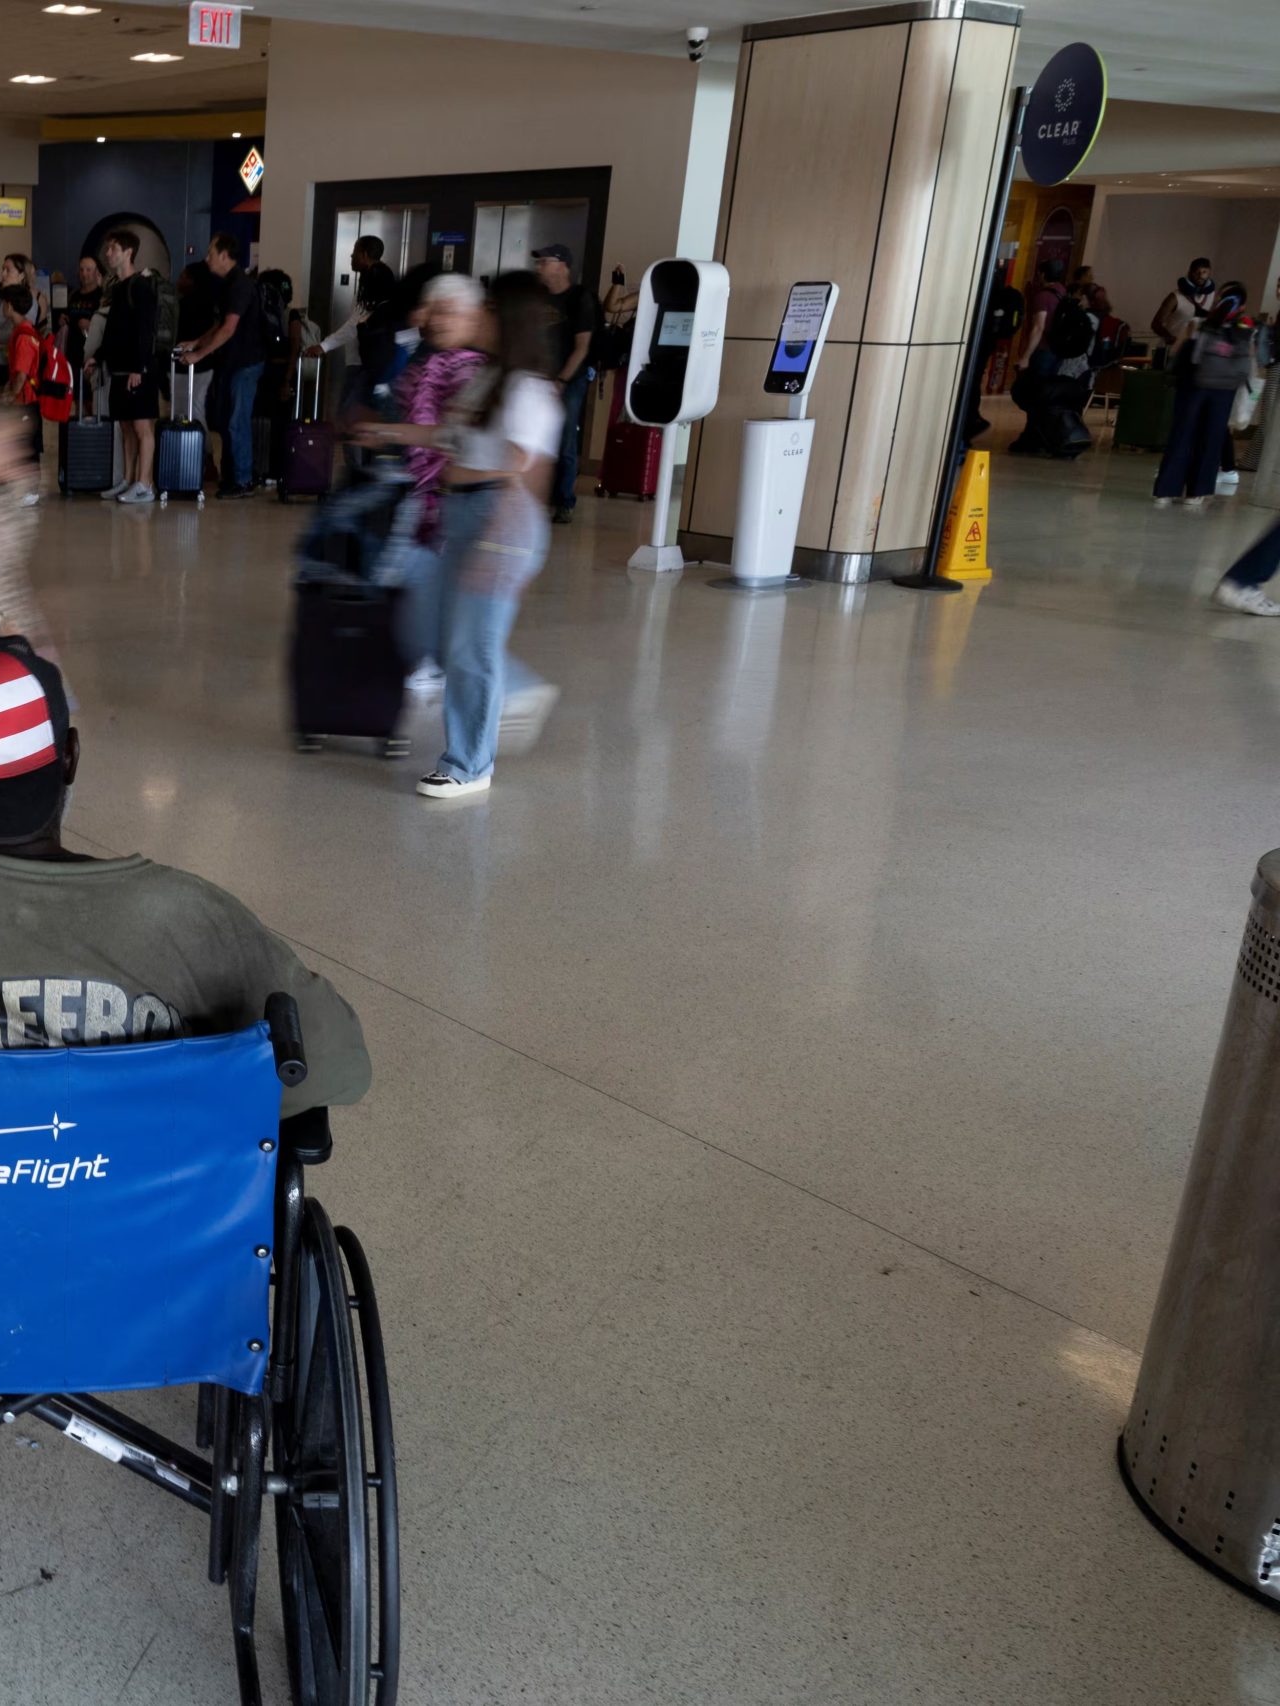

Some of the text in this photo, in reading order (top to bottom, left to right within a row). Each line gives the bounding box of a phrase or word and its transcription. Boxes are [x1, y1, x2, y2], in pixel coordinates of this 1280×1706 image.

[200, 9, 233, 44] EXIT
[1038, 120, 1080, 139] CLEAR
[783, 448, 804, 457] CLEAR
